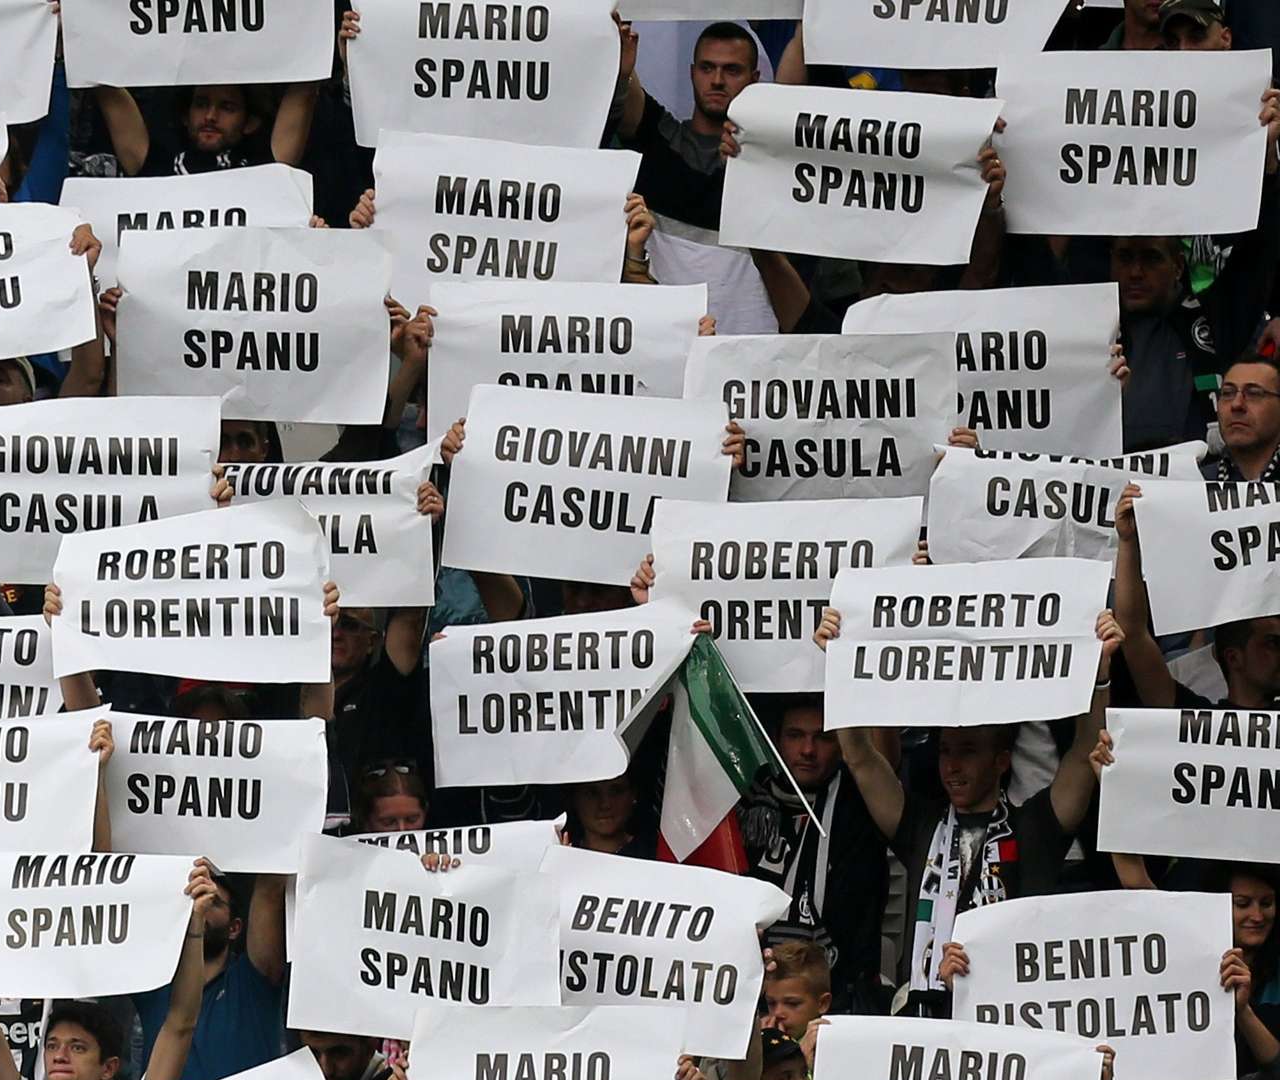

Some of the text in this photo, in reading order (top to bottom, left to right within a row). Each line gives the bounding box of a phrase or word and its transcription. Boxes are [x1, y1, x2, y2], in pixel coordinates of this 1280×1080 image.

[418, 1, 549, 43] MARIO
[413, 57, 550, 102] SPANU
[1064, 87, 1197, 129] MARIO
[790, 112, 922, 162] MARIO
[791, 159, 928, 214] SPANU
[1059, 143, 1198, 187] SPANU
[434, 175, 562, 223] MARIO
[186, 270, 318, 314] MARIO
[495, 425, 692, 479] GIOVANNI
[734, 433, 903, 483] CASULA
[97, 540, 285, 581] ROBERTO
[81, 596, 300, 638] LORENTINI
[872, 592, 1061, 628] ROBERTO
[472, 629, 654, 675] ROBERTO
[853, 643, 1073, 682] LORENTINI
[6, 903, 130, 949] SPANU
[363, 889, 490, 948] MARIO
[571, 894, 715, 942] BENITO
[360, 947, 490, 1005] SPANU
[1015, 933, 1167, 983] BENITO
